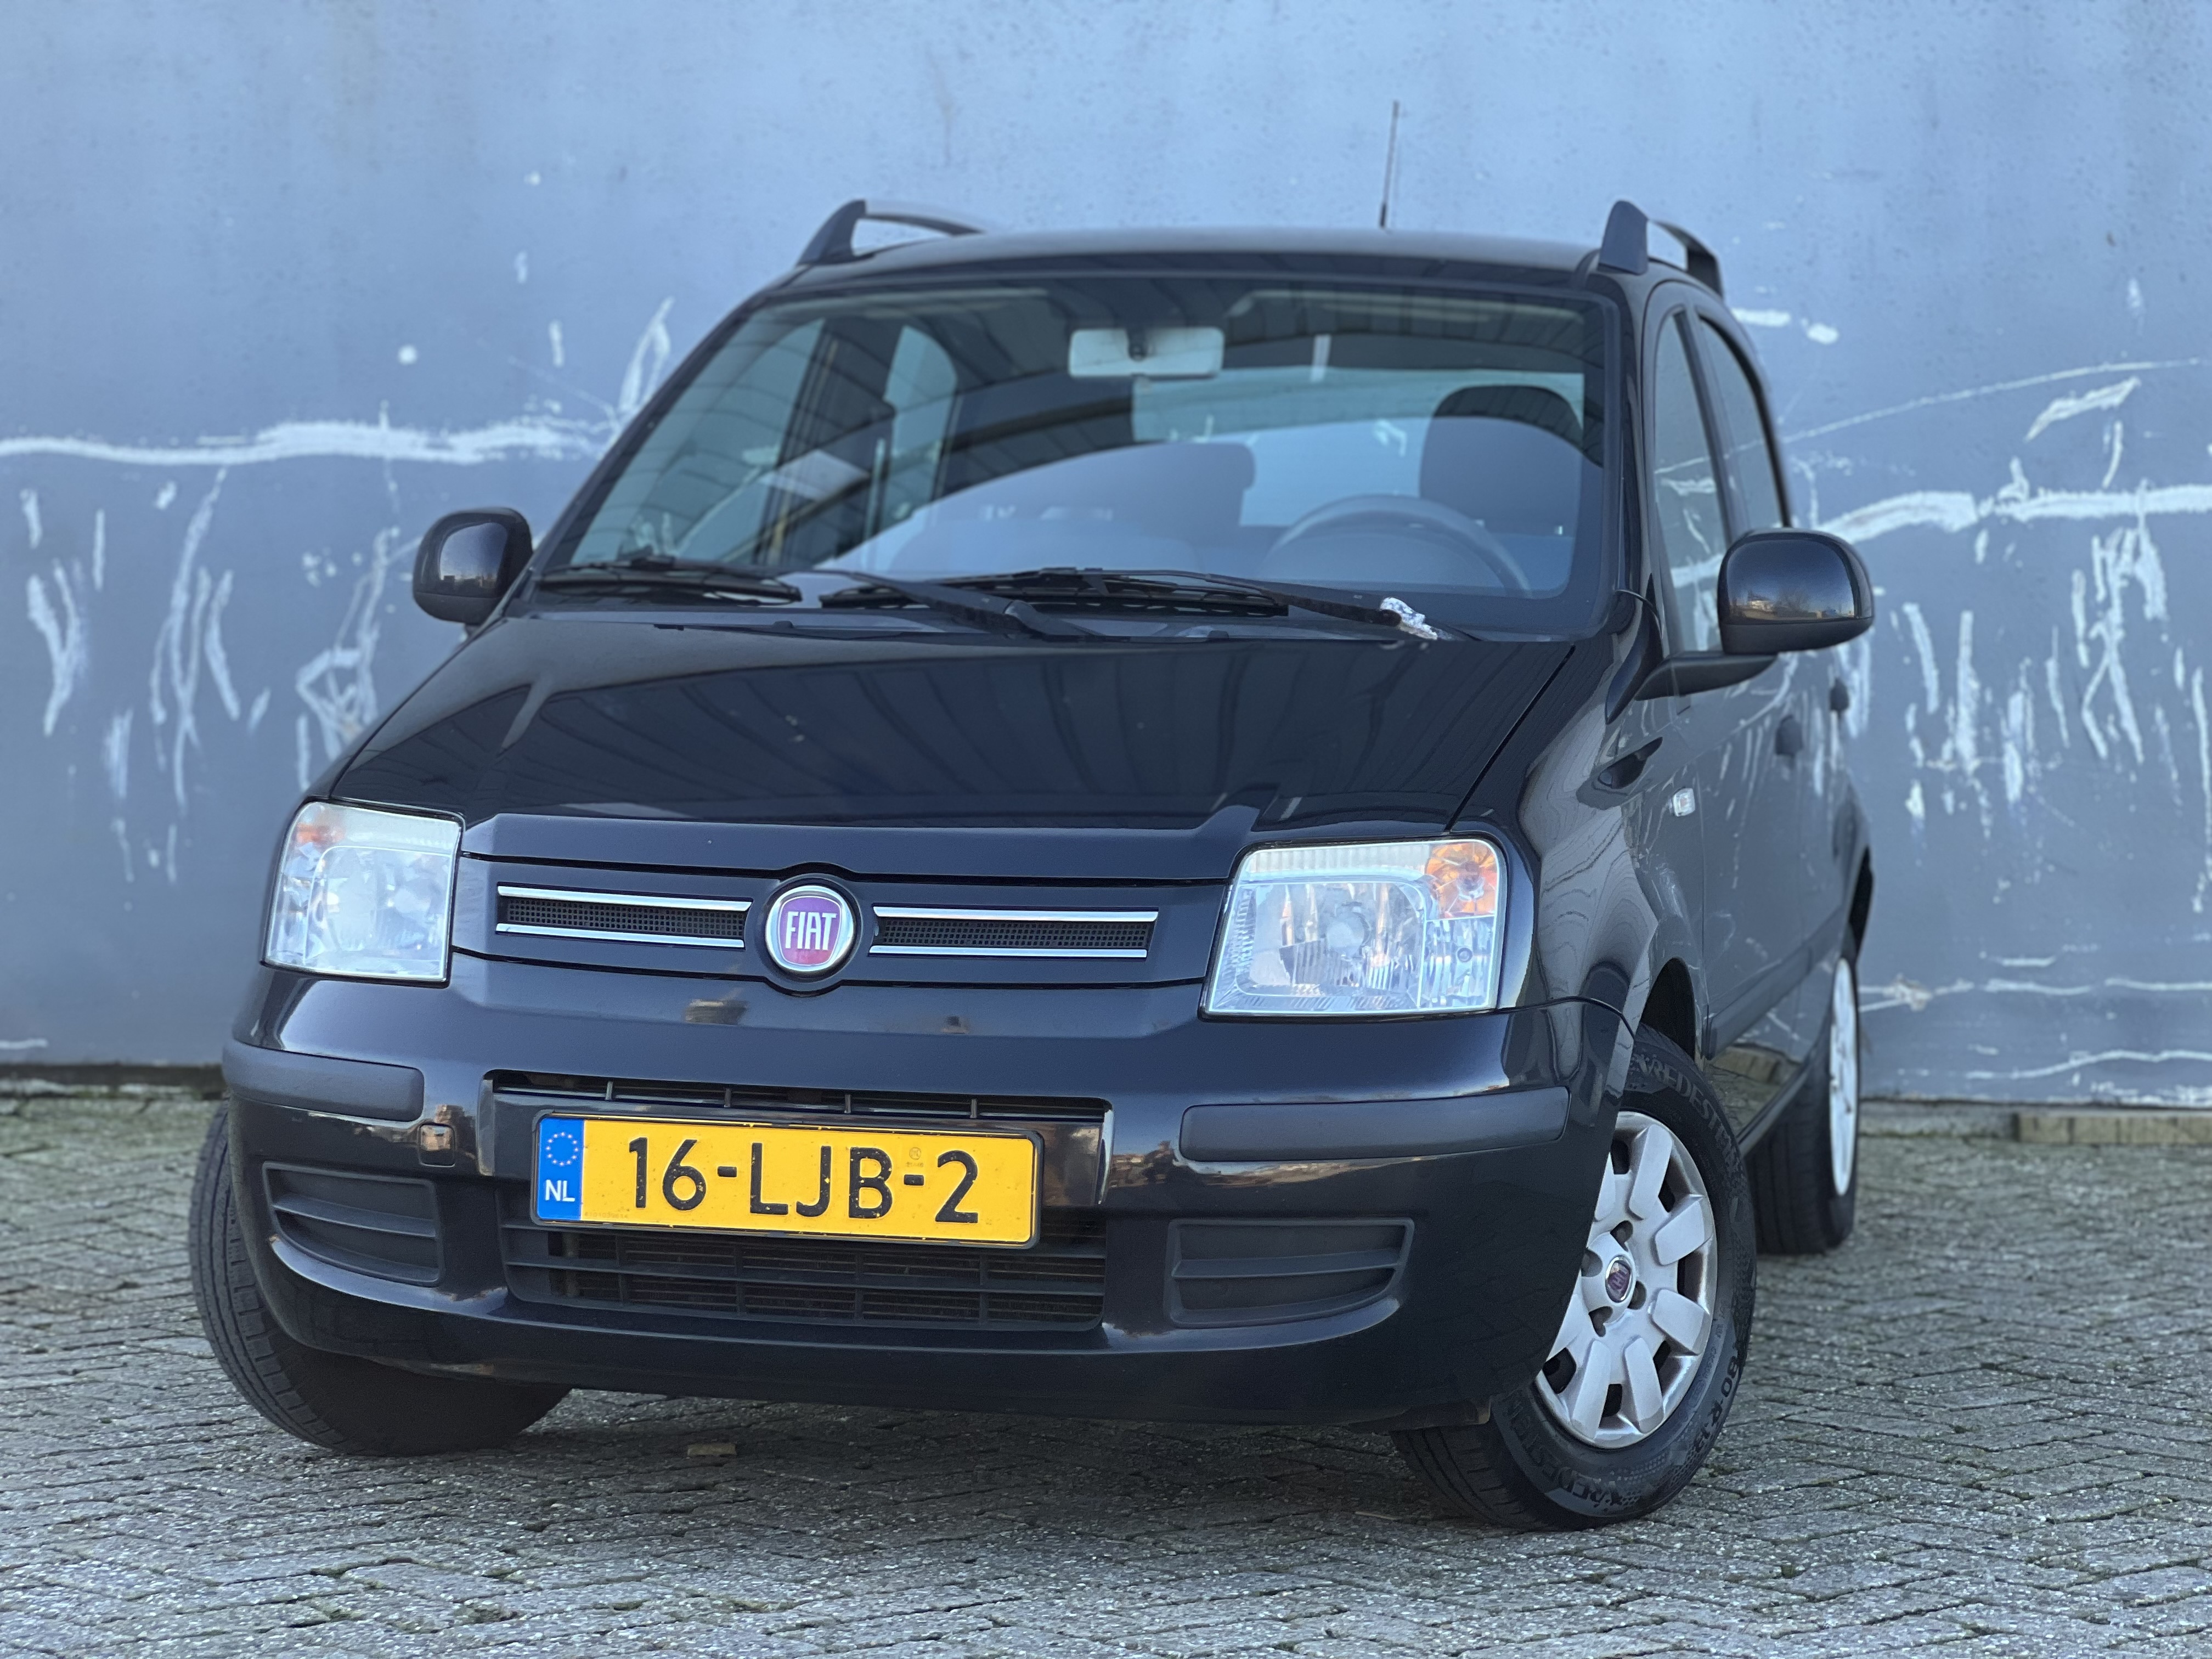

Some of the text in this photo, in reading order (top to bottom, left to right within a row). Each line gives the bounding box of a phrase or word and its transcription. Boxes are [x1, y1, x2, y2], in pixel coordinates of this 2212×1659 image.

[785, 911, 837, 950] FIAT
[545, 1179, 575, 1201] NL
[629, 1137, 979, 1223] 16-LJB-2
